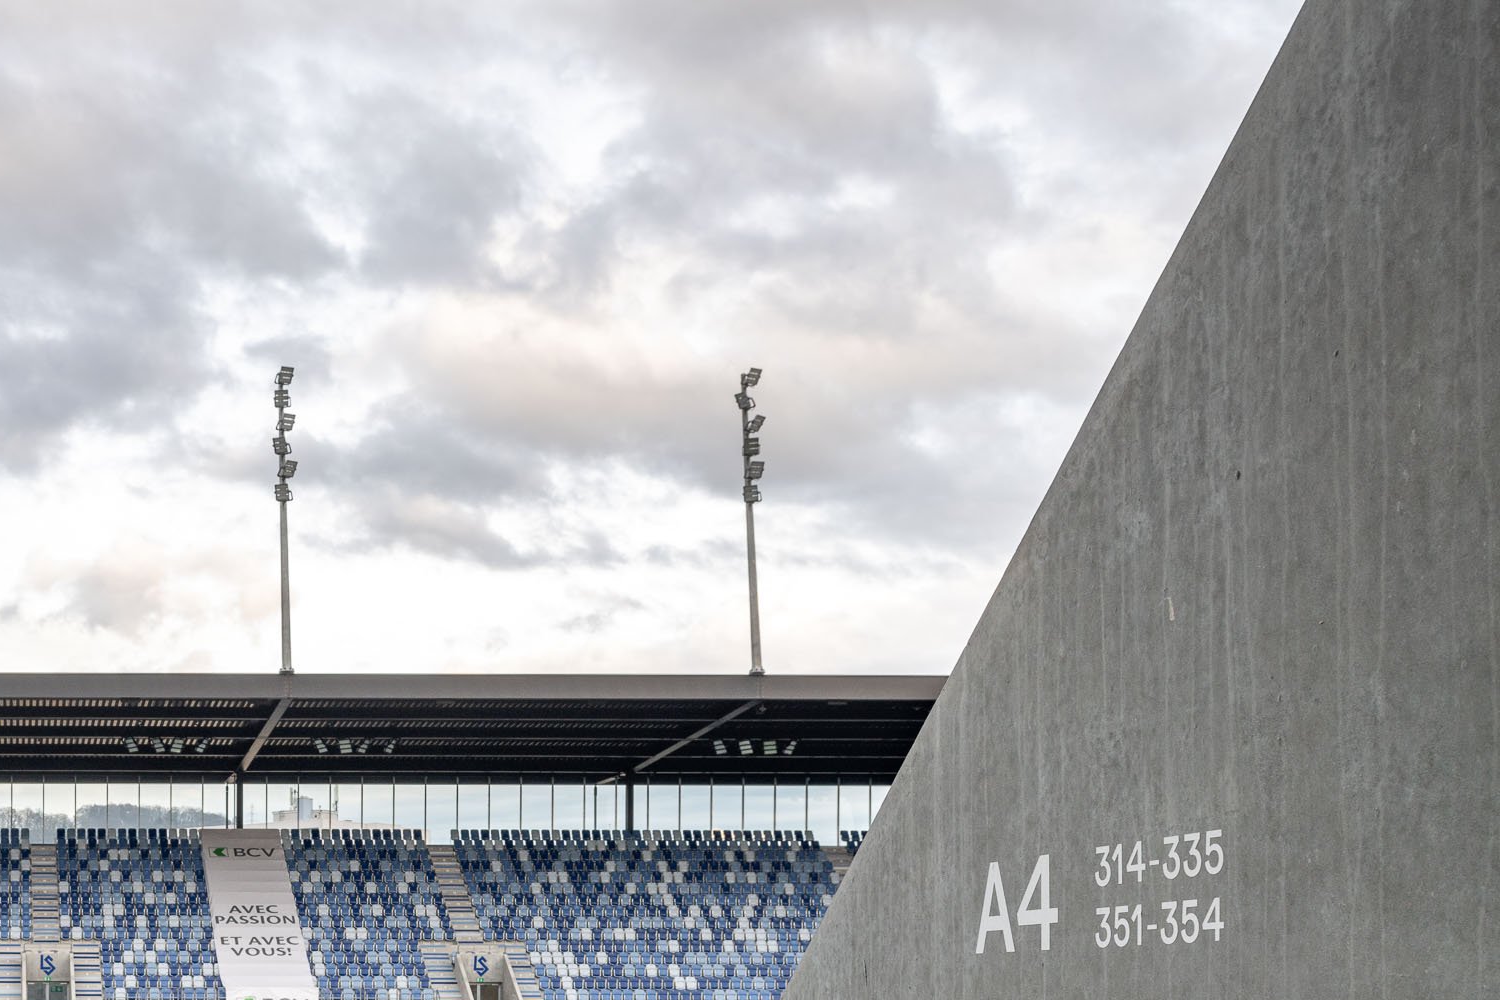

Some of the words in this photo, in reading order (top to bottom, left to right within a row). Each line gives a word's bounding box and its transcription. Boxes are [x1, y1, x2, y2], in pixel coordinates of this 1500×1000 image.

[233, 847, 275, 857] BCV
[1094, 829, 1224, 887] 314-335
[975, 854, 1058, 954] A4
[229, 905, 279, 914] AVEC
[215, 915, 296, 925] PASSION
[1094, 897, 1224, 948] 351-354
[220, 936, 242, 946] ET
[248, 936, 299, 946] AVEC
[231, 947, 292, 957] VOUS!
